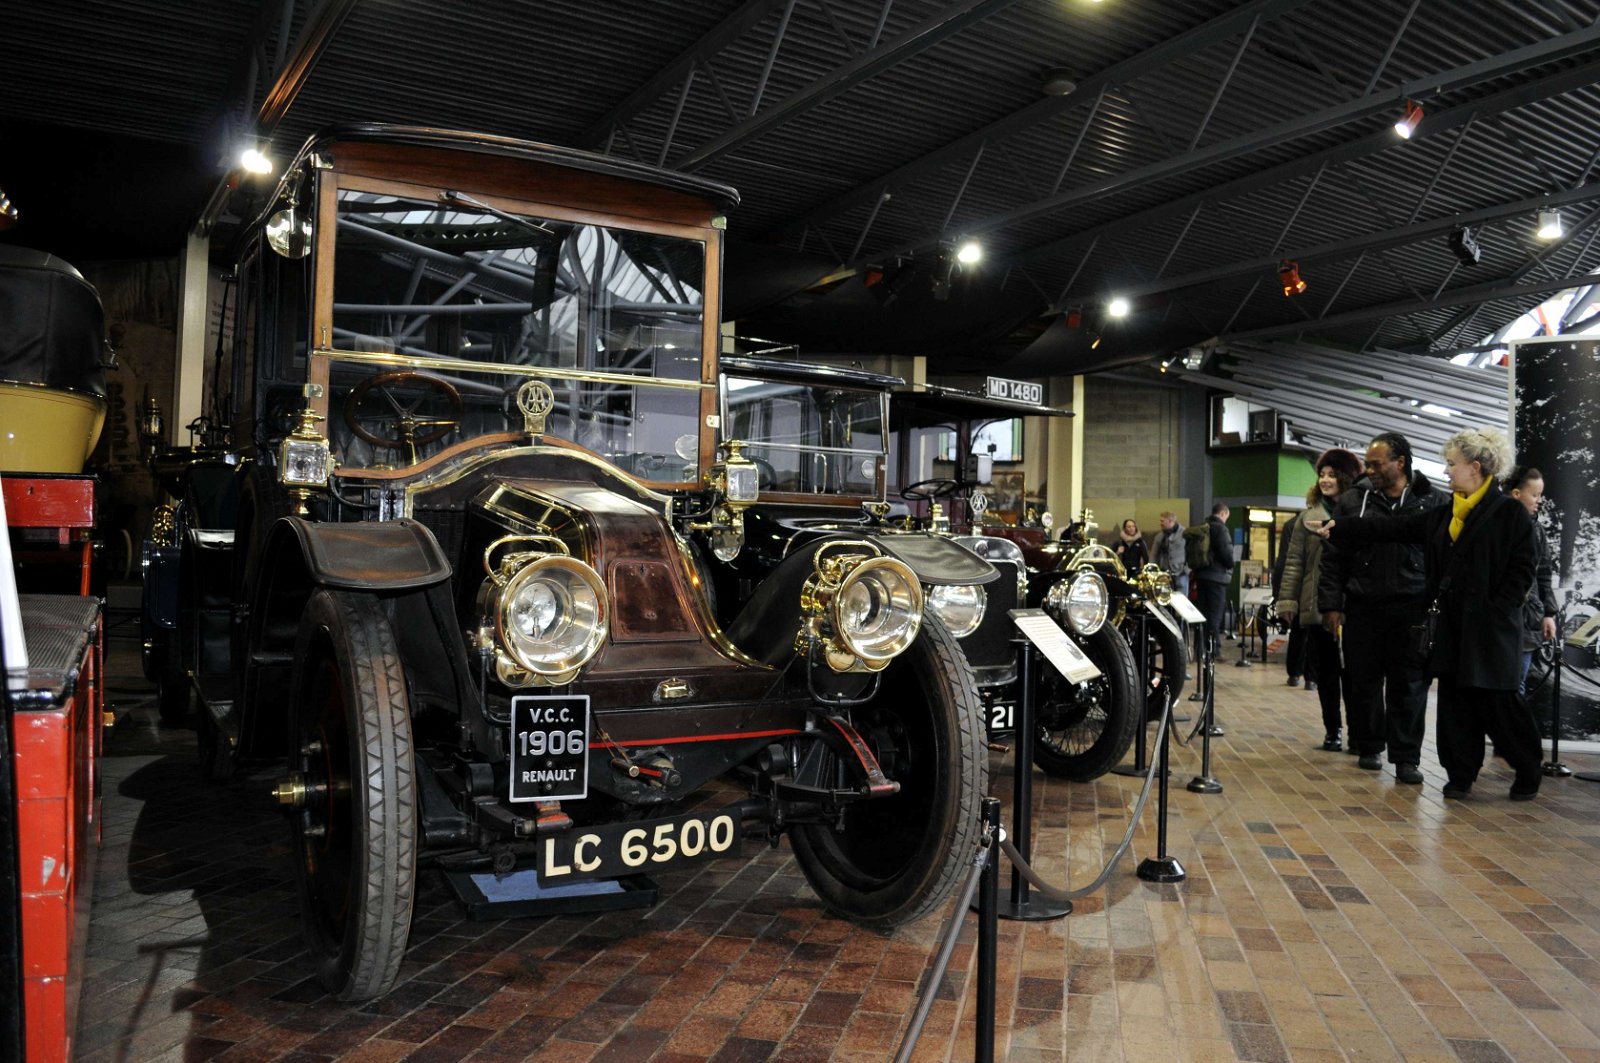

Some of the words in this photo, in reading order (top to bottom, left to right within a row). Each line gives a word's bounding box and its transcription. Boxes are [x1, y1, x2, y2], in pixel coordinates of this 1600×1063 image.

[990, 379, 1007, 397] MD
[1010, 383, 1039, 402] 1480
[529, 708, 574, 724] V.C.C.
[519, 730, 584, 756] 1906
[522, 768, 577, 784] RENAULT
[545, 833, 603, 877] LC
[620, 815, 735, 867] 6500
